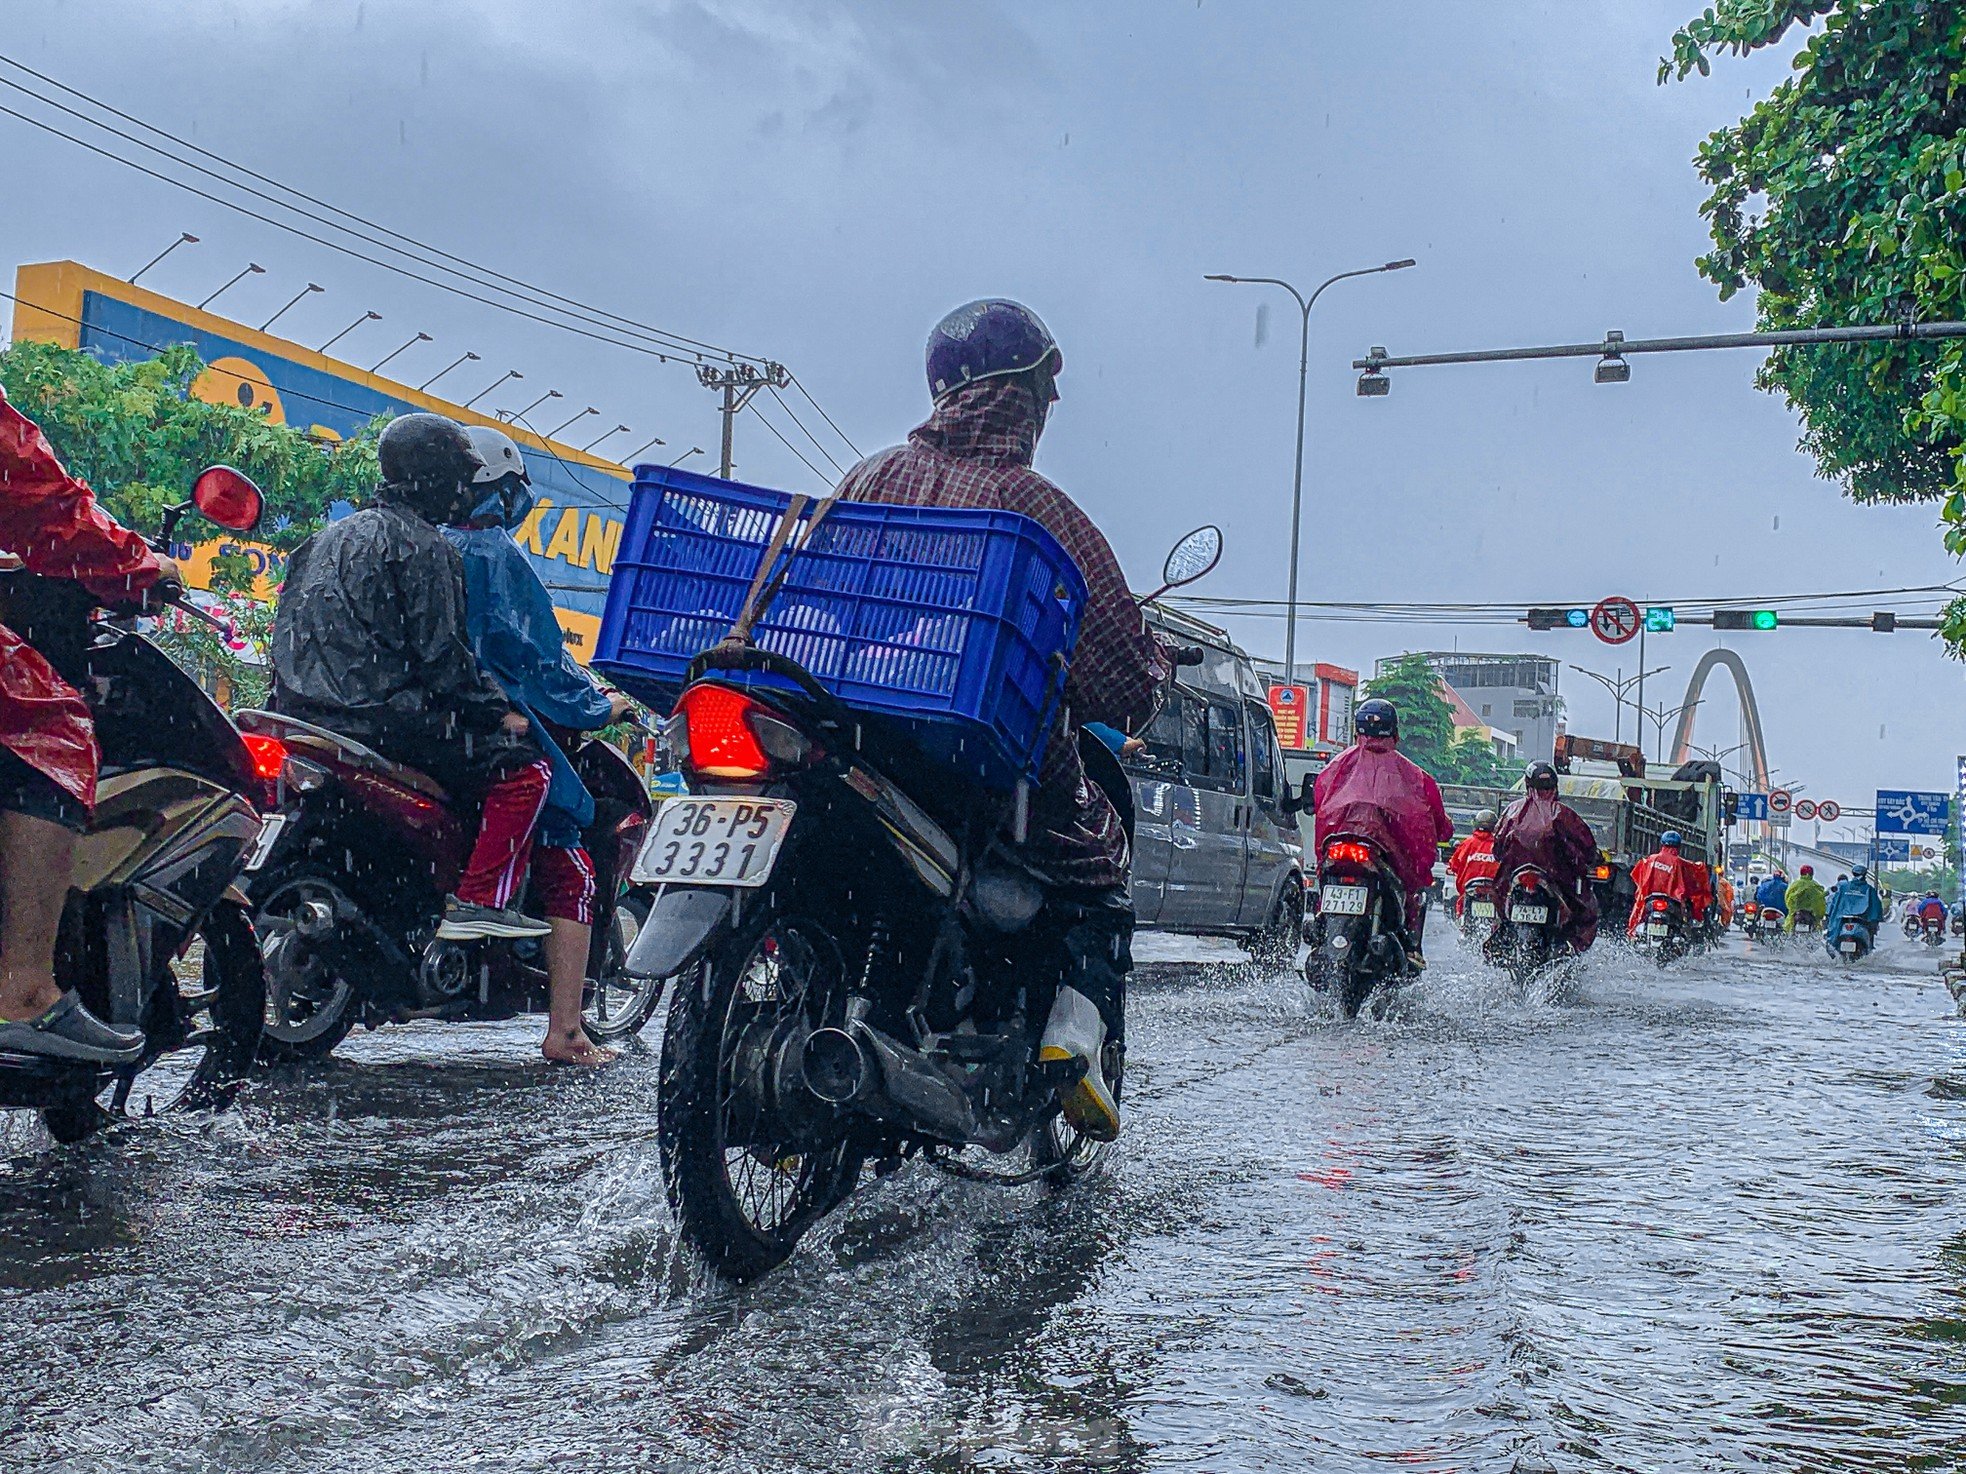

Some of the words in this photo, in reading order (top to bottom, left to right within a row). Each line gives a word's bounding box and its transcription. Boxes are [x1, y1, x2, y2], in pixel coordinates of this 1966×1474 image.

[1647, 610, 1672, 630] 24
[673, 803, 775, 839] 36-P5
[655, 841, 757, 879] 3331
[1330, 888, 1360, 900] 43-F1
[1325, 900, 1363, 912] 271.29
